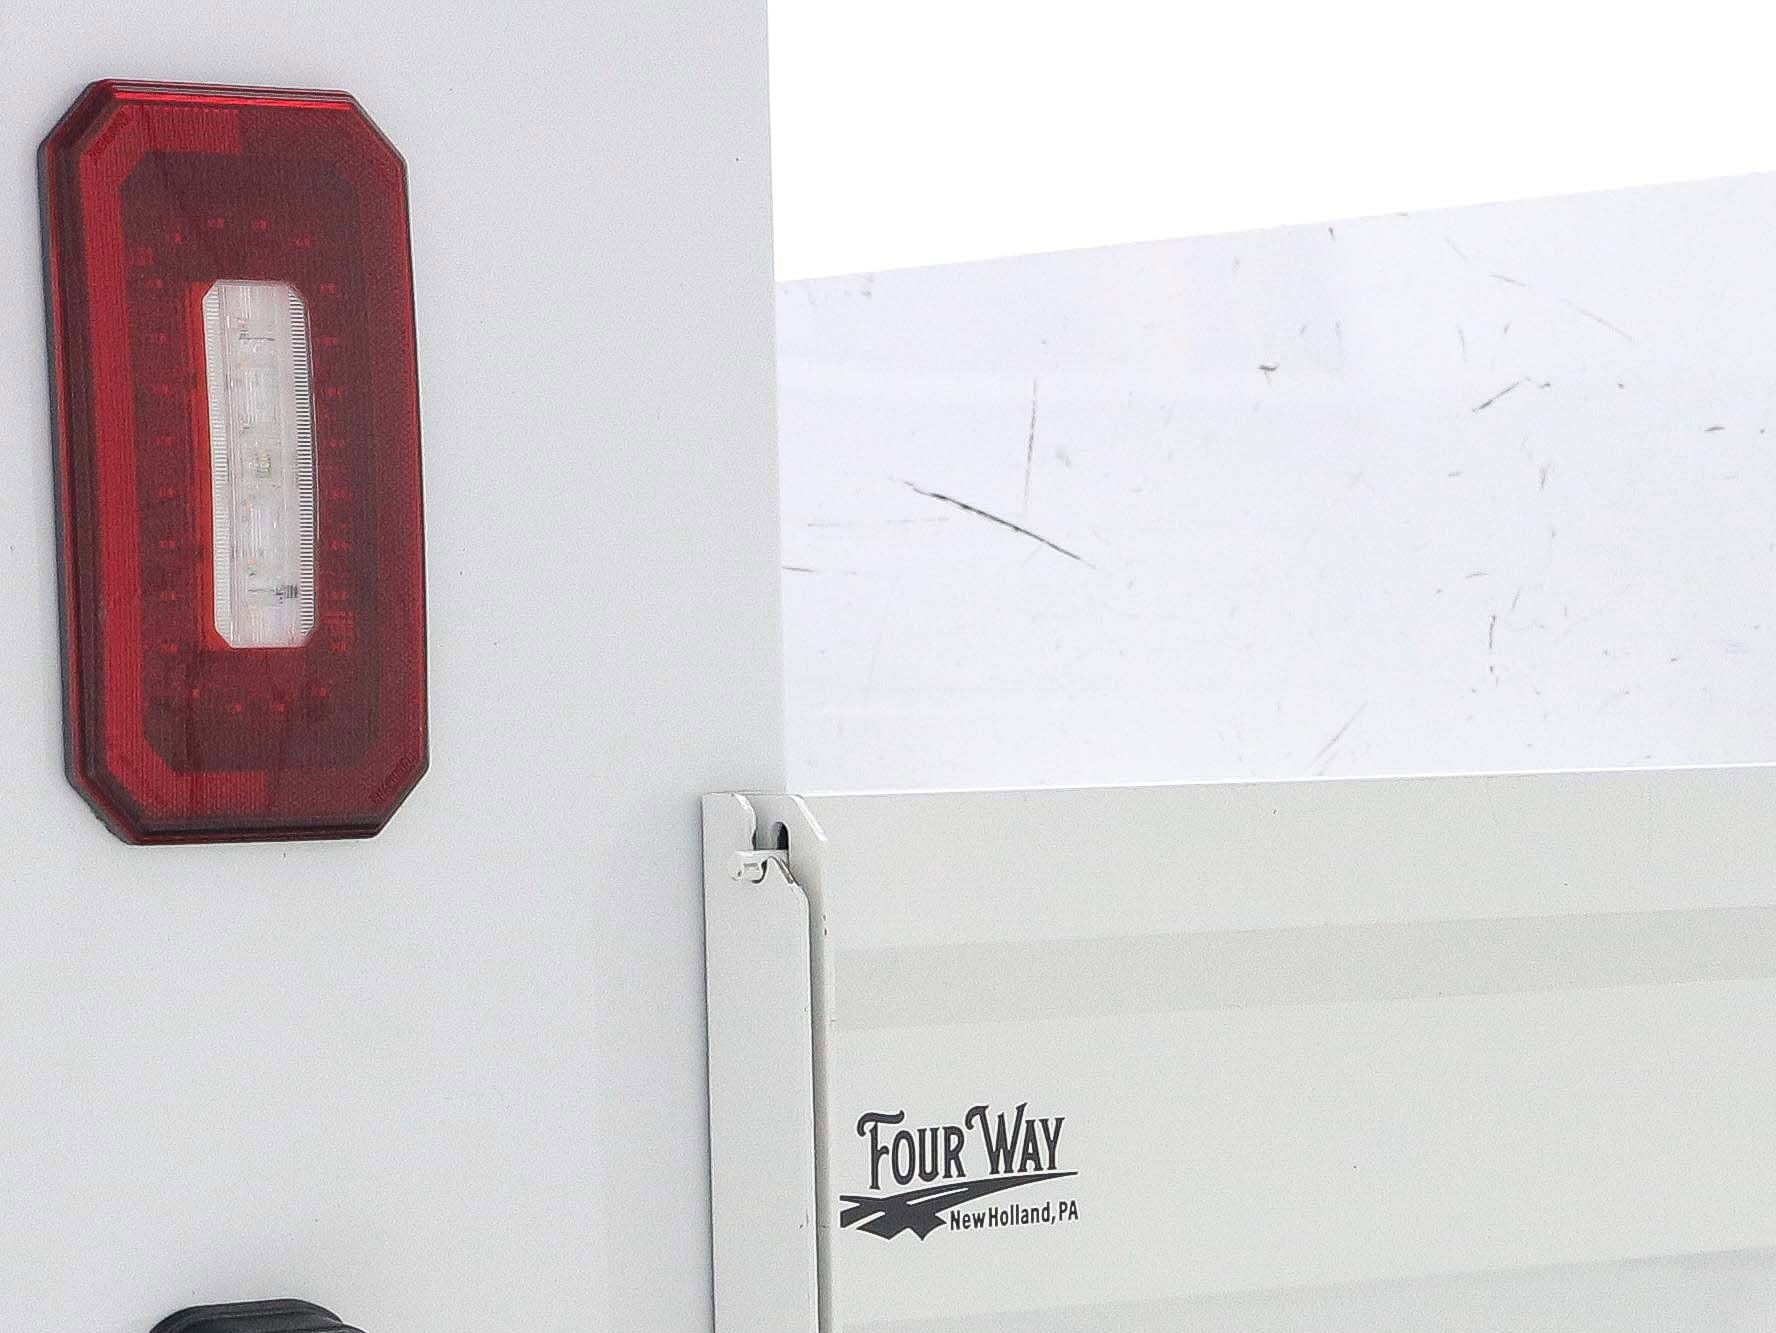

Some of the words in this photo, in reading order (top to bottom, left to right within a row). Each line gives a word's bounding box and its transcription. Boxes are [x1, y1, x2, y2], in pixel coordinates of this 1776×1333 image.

[856, 1109, 967, 1191] FOUR
[965, 1102, 1066, 1175] WAY
[950, 1209, 987, 1232] New
[988, 1201, 1056, 1228] Holland,
[1059, 1200, 1080, 1222] PA
